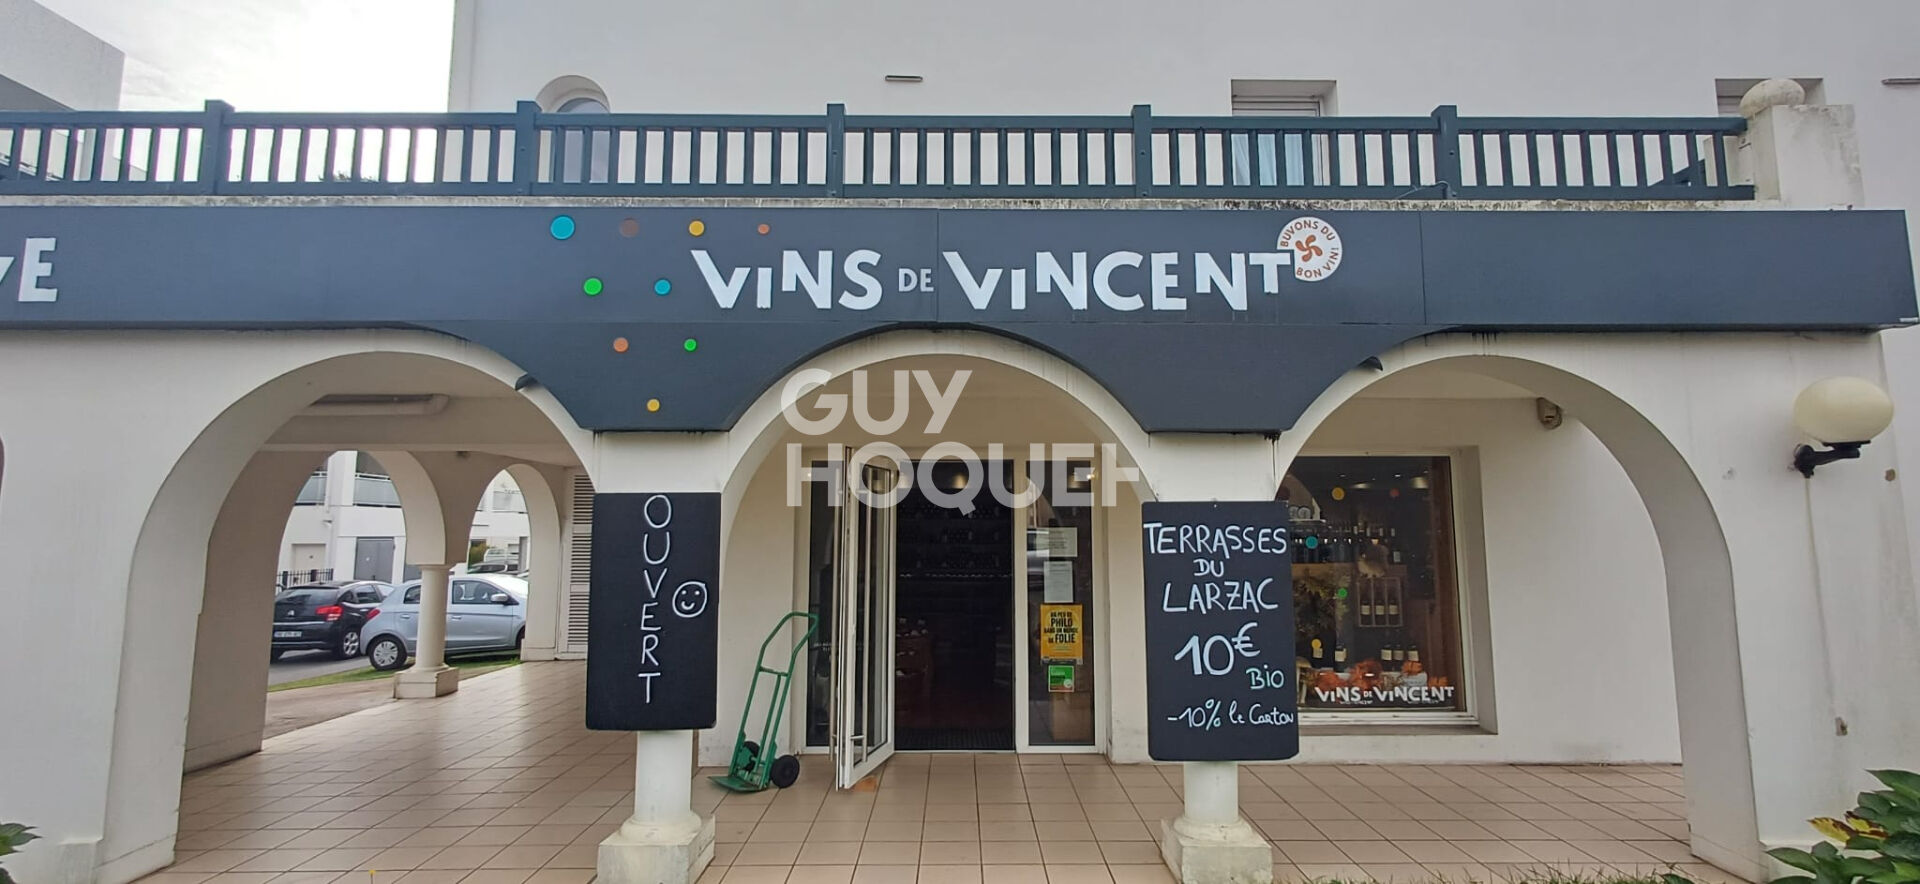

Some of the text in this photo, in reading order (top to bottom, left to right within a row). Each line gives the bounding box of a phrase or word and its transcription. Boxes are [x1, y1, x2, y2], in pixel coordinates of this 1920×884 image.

[1280, 219, 1336, 247] BUVONS DU
[1296, 247, 1339, 279] BON VIN!
[690, 249, 1291, 311] VINS DE VINCENT
[1143, 522, 1287, 559] TERRASSES
[1193, 559, 1224, 577] DU
[638, 494, 672, 703] OUVERT
[1162, 577, 1279, 614] LARZAC
[1051, 617, 1073, 627] PHILO
[1055, 633, 1076, 643] FOLIE
[1174, 621, 1260, 676] 10€
[1314, 686, 1361, 702] VINS
[1373, 686, 1454, 702] VINCENT
[1167, 698, 1222, 731] -10%
